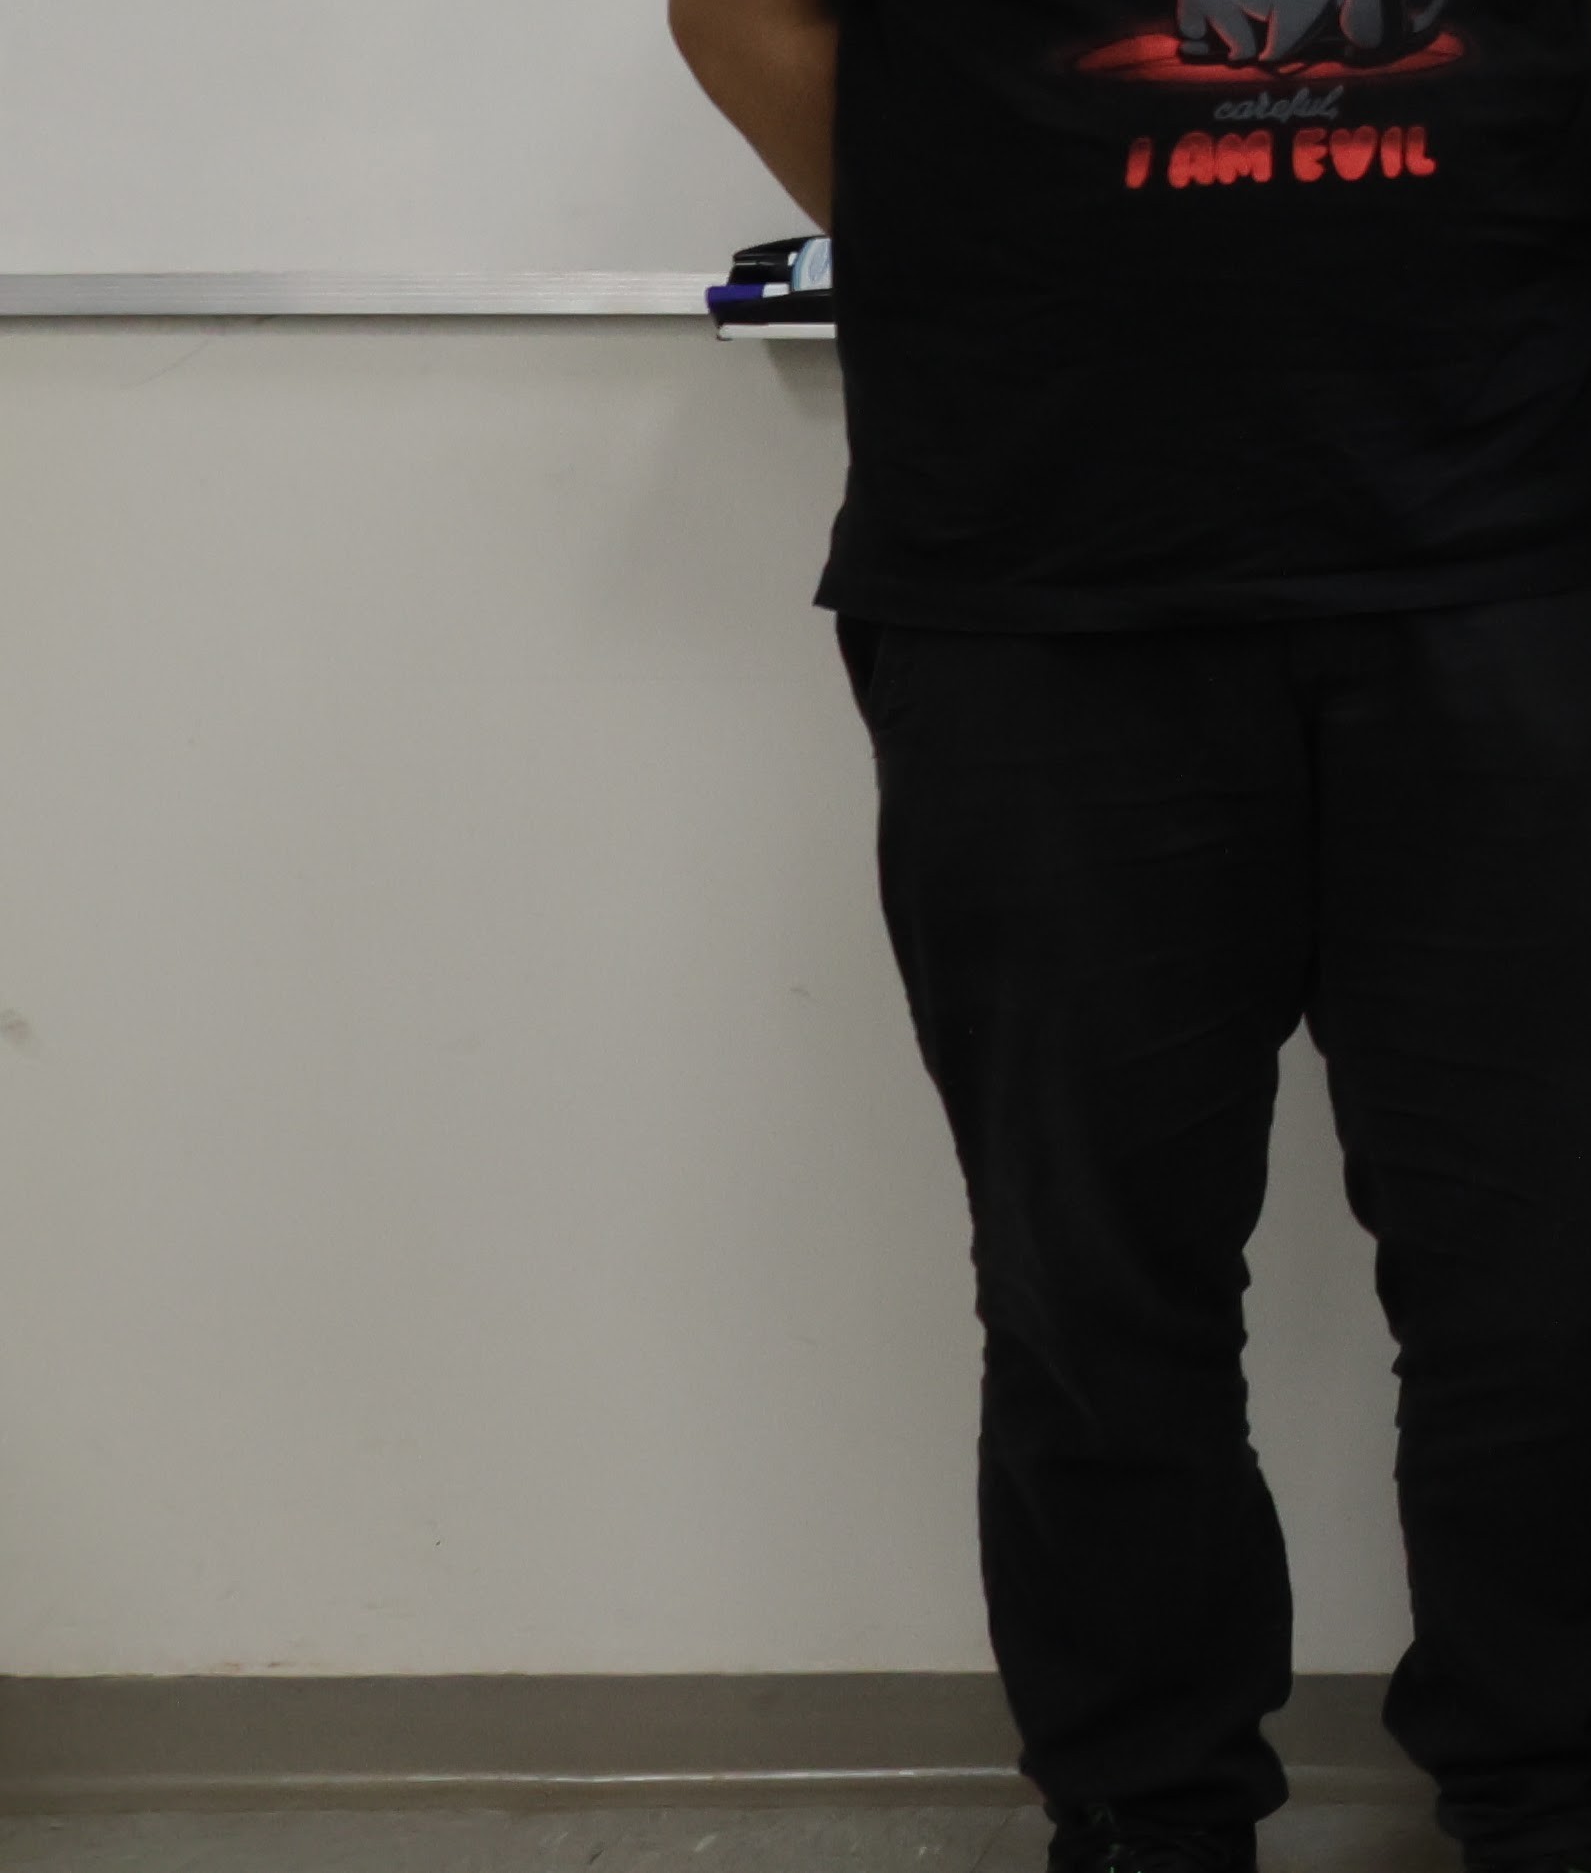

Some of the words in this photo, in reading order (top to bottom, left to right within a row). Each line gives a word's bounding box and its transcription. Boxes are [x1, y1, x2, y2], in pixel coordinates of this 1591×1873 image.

[1124, 136, 1153, 190] I
[1168, 130, 1274, 189] AM
[1292, 125, 1436, 182] EVIL
